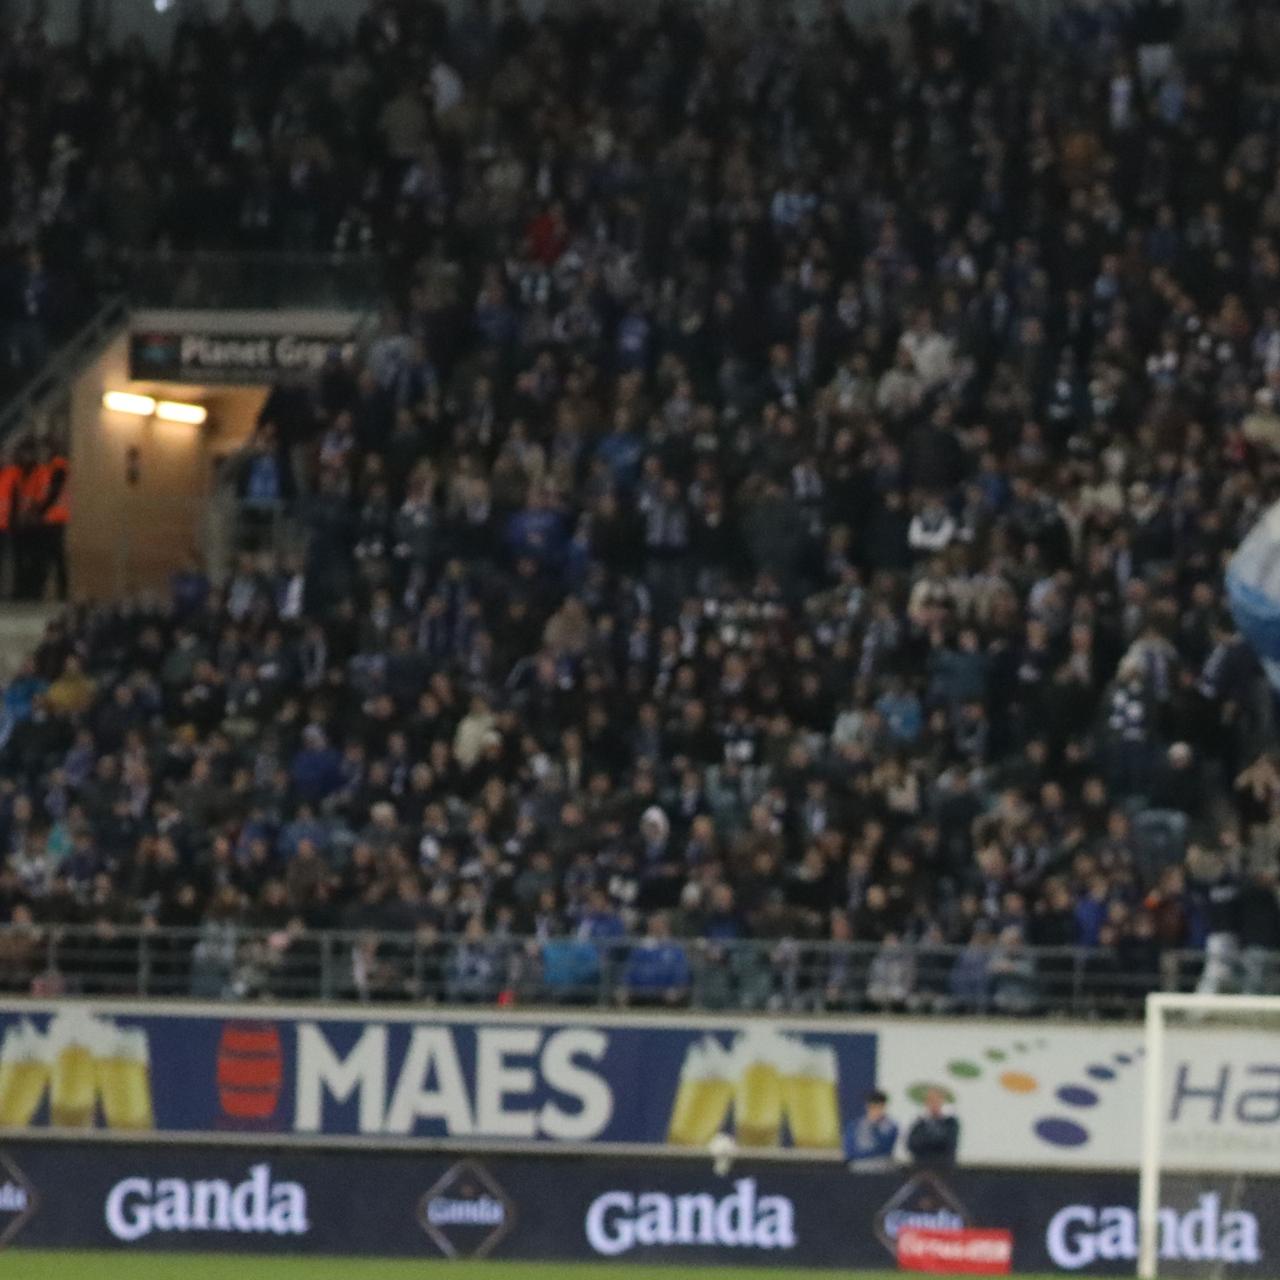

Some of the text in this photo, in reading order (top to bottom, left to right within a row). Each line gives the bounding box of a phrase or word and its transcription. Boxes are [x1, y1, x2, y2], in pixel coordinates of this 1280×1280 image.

[294, 1021, 616, 1141] MAES
[104, 1163, 309, 1242] Ganda
[585, 1157, 797, 1256] Ganda
[1045, 1190, 1260, 1271] Ganda
